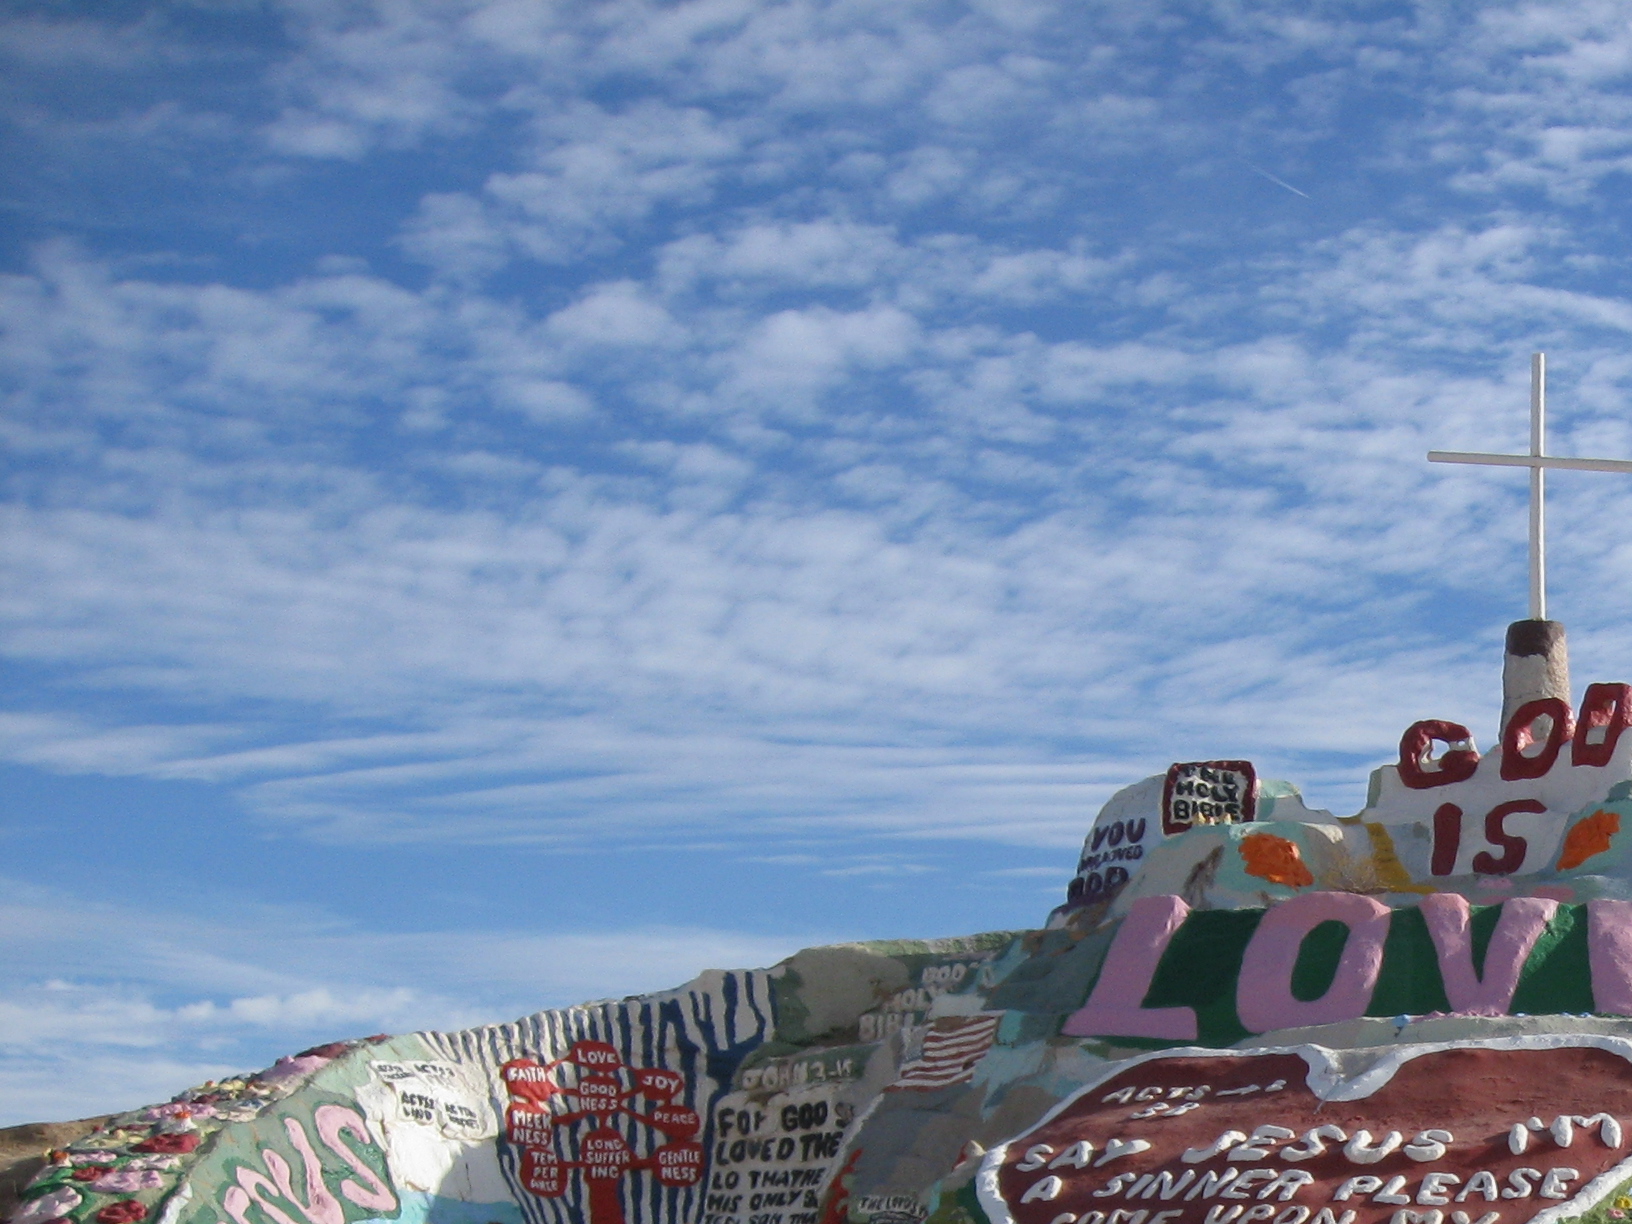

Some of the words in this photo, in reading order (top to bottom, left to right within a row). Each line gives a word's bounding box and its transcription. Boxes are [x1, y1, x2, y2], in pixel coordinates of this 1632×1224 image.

[1175, 780, 1240, 803] HOLY
[1090, 817, 1147, 851] YOU
[1431, 799, 1548, 876] IS
[577, 1048, 617, 1065] LOVE
[507, 1066, 546, 1083] FAITH
[579, 1081, 617, 1097] GOOD
[642, 1075, 680, 1093] JOY
[1101, 1084, 1212, 1104] ACTS
[580, 1098, 618, 1111] NESS
[654, 1110, 696, 1125] PEACE
[512, 1130, 548, 1147] NESS
[587, 1139, 624, 1151] LONG
[1015, 1138, 1152, 1173] SAY
[1180, 1123, 1455, 1165] JESUS
[1507, 1112, 1623, 1156] I'M
[715, 1137, 796, 1167] LOVED
[799, 1131, 843, 1162] THE
[531, 1151, 558, 1165] TEM
[585, 1151, 631, 1166] SUFFER
[658, 1150, 700, 1166] GENTLE
[533, 1166, 558, 1178] PER
[591, 1166, 619, 1179] ING
[661, 1166, 697, 1182] NESS
[1020, 1174, 1064, 1204] A
[1091, 1166, 1315, 1201] SINNER
[1332, 1166, 1580, 1206] PLEASE
[750, 1189, 802, 1211] ONLY
